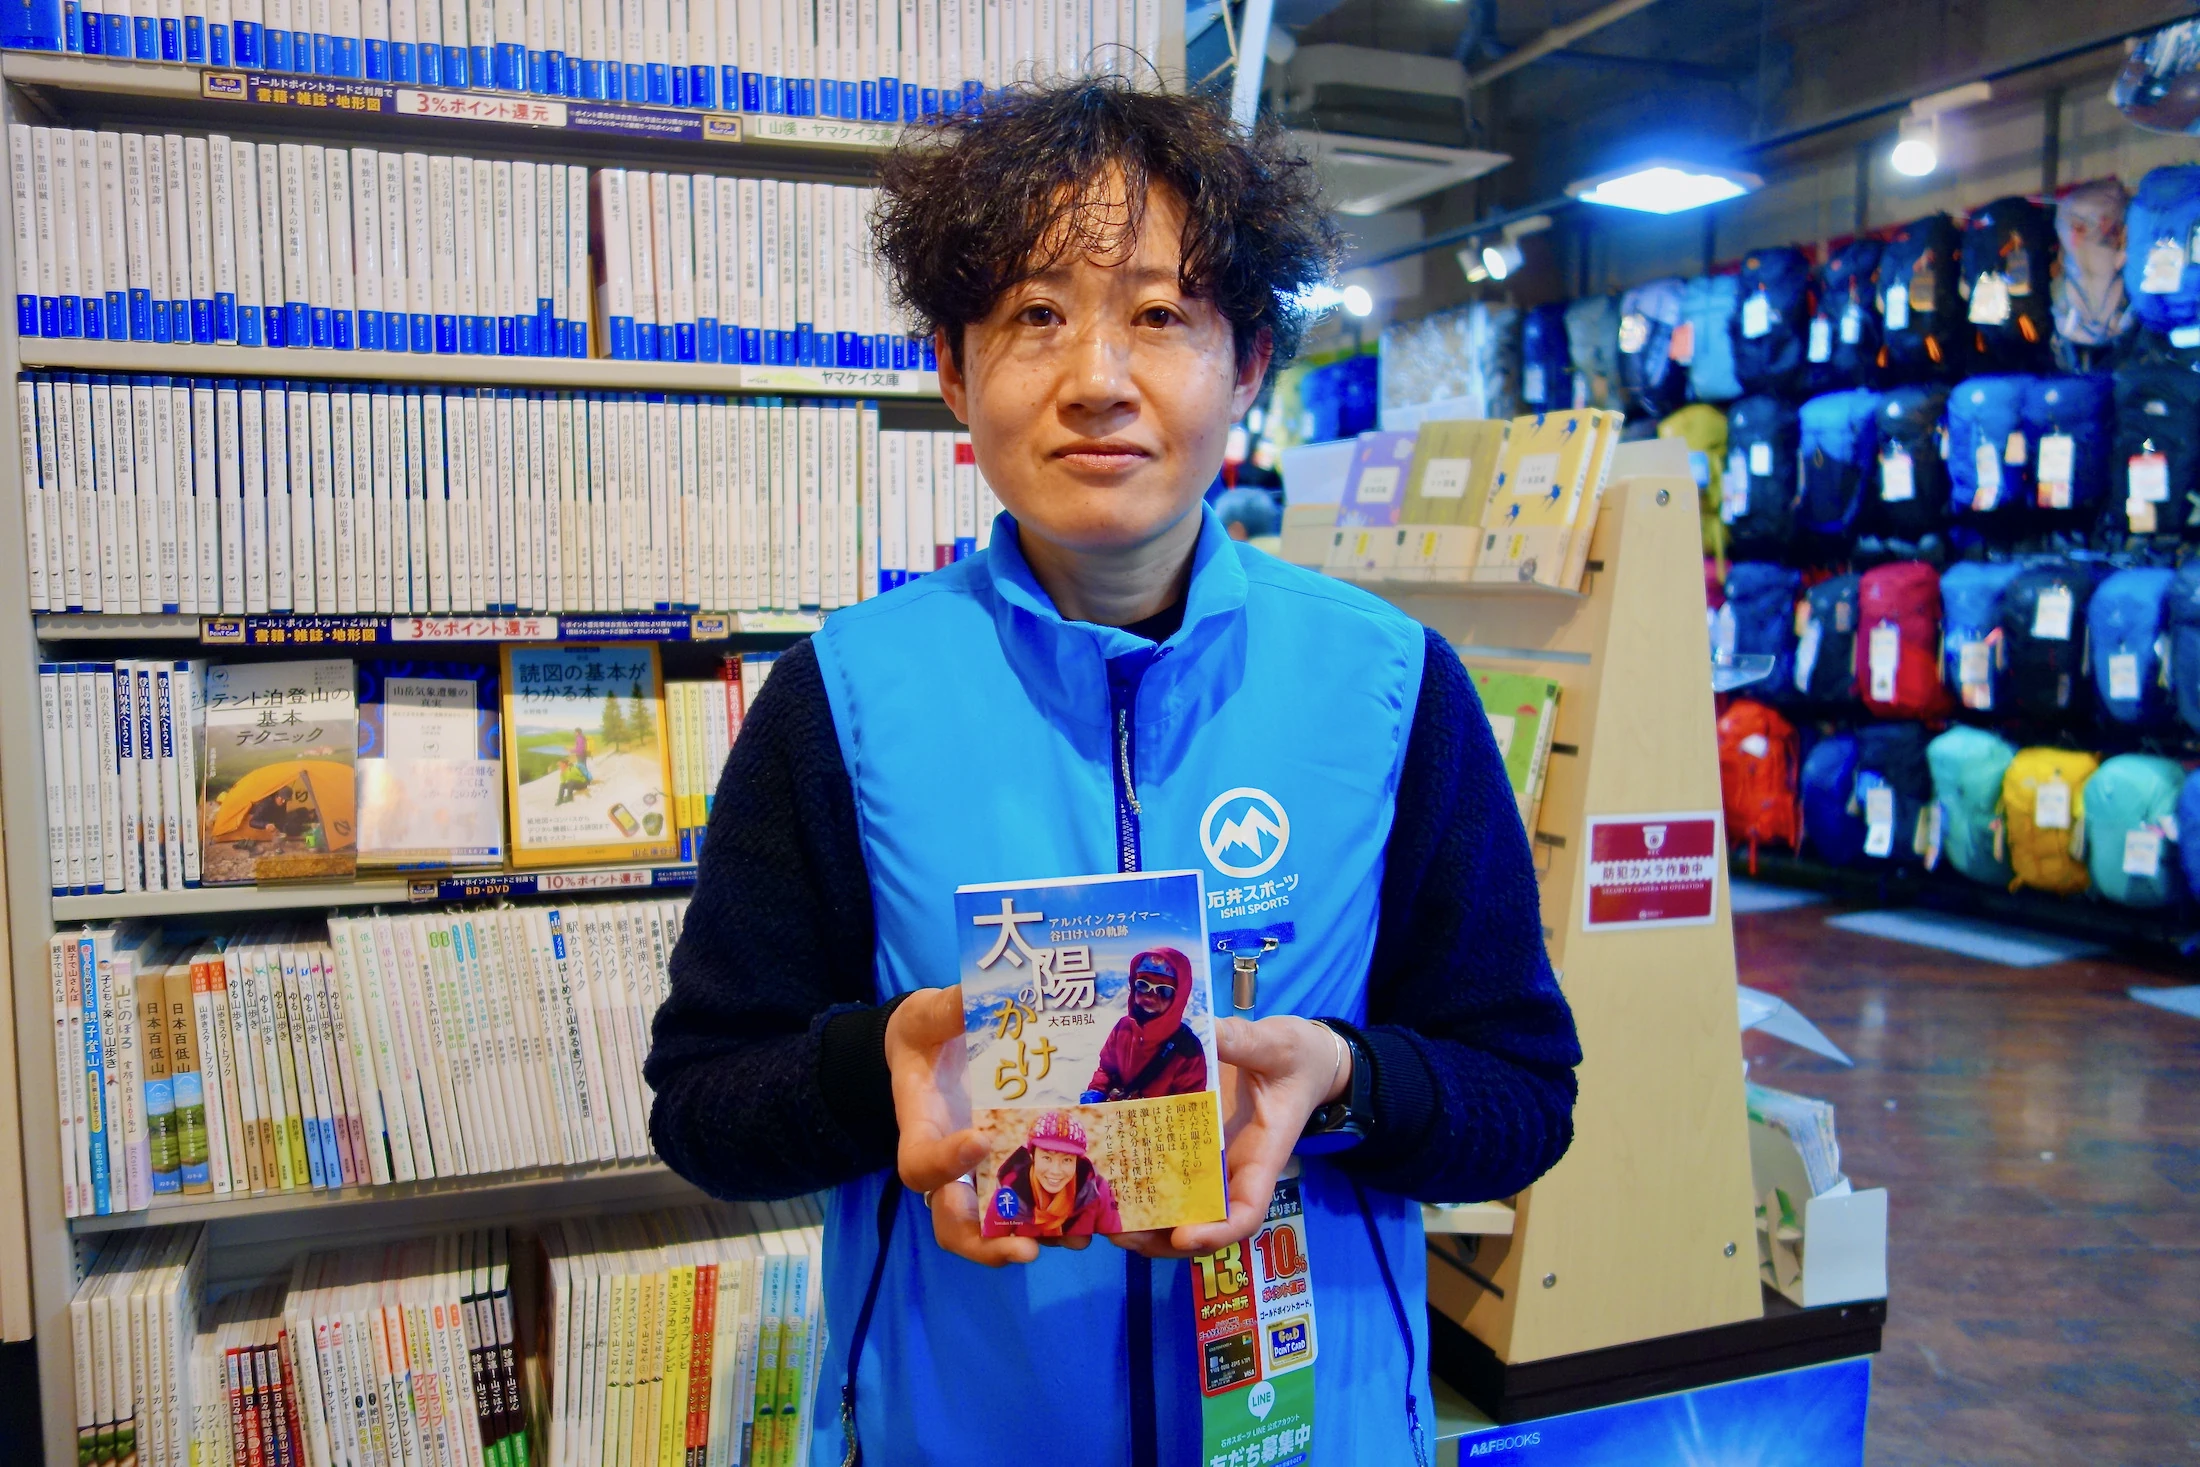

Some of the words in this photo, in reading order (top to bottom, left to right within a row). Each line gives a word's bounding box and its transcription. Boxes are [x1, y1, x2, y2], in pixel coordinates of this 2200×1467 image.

[250, 78, 393, 98] ゴールドポイントカードご利用で
[257, 88, 381, 112] 書籍・雑誌・地形図
[417, 92, 549, 122] 3%ポイント還元
[15, 154, 26, 199] 黒部の山賊
[37, 155, 48, 200] 黒部の山賊
[129, 156, 140, 207] 黒部の山人
[169, 142, 180, 190] マタギ奇談
[213, 143, 225, 205] 山怪実話大全
[333, 171, 342, 201] 単独行
[362, 158, 371, 198] 単独行者
[387, 163, 396, 203] 単独行者
[287, 166, 299, 256] 山小屋主人の炉端話
[822, 371, 899, 386] ヤマケイ文庫
[59, 396, 71, 468] もう道に迷わない
[76, 398, 89, 490] 山のリスクセンスを磨く本
[116, 399, 128, 473] 体験的登山技術論
[139, 400, 149, 464] 体験的山道具考
[357, 406, 367, 490] これでいいのか登山道
[392, 409, 402, 488] 日本の山はすごい！
[410, 408, 421, 496] 今そこにある山の危険
[516, 412, 526, 478] もう道に迷わない
[531, 412, 541, 481] アルピニズムと死
[249, 619, 387, 628] ゴールドポイントカードご利用で
[256, 629, 376, 642] 書籍・雑誌・地形図
[411, 620, 540, 638] 3%ポイント還元
[211, 687, 350, 708] テント泊登山の
[393, 686, 468, 697] 山岳気象遭難の
[519, 661, 646, 683] 読図の基本が
[521, 683, 599, 703] わかる本
[118, 675, 131, 758] 登山外来へようこそ
[138, 676, 151, 759] 登山外来へようこそ
[159, 677, 171, 758] 登山外来へようこそ
[257, 709, 304, 727] 基本
[421, 698, 442, 708] 真実
[179, 684, 189, 778] テント泊登山の基本テクニック
[236, 727, 324, 746] テクニック
[440, 876, 534, 887] ゴールドポイントカードご利用で
[466, 885, 510, 896] BD・DVD
[545, 873, 645, 891] 10%ポイント還元
[1206, 873, 1299, 909] 石井スポーツ
[1602, 863, 1704, 881] 防犯カメラ作動中
[1602, 887, 1632, 895] SECURITY
[1669, 883, 1704, 892] OPERATION
[1049, 911, 1160, 928] アルパインクライマー
[1221, 906, 1246, 919] ISHII
[1248, 895, 1290, 914] SPORTS
[566, 922, 586, 991] 駅からハイク
[584, 923, 602, 981] 秩父ハイク
[600, 922, 618, 980] 秩父ハイク
[617, 920, 636, 992] 軽井沢ハイク
[1050, 926, 1128, 942] 谷口けいの軌跡
[53, 946, 64, 1003] 親子で山さんぽ
[67, 945, 79, 1002] 親子で山さんぽ
[335, 933, 354, 1001] 低山トラベル
[360, 932, 378, 999] 低山トラベル
[381, 949, 399, 1008] 低山トラベル
[402, 948, 421, 1008] 低山トラベル
[503, 927, 518, 1000] アルプスはじめました
[635, 938, 652, 995] 湘南ハイク
[101, 974, 117, 1068] 子どもと楽しむ山歩き
[229, 980, 243, 1031] ゆる山歩き
[245, 979, 258, 1030] ゆる山歩き
[260, 995, 273, 1045] ゆる山歩き
[274, 991, 288, 1041] ゆる山歩き
[289, 992, 302, 1043] ゆる山歩き
[304, 994, 317, 1044] ゆる山歩き
[317, 991, 331, 1041] ゆる山歩き
[331, 992, 345, 1042] ゆる山歩き
[423, 965, 442, 1047] 東京近郊の入門山ハイク
[558, 963, 586, 1091] はじめての山あるきブック
[1048, 1014, 1095, 1027] 大石明弘
[83, 1012, 100, 1067] 親子登山
[147, 1003, 165, 1075] 日本百低山
[172, 1003, 190, 1074] 日本百低山
[199, 1006, 214, 1078] 山歩きスタートブック
[216, 1004, 231, 1076] 山歩きスタートブック
[1152, 1107, 1166, 1173] はじめて知った。
[1165, 1105, 1176, 1151] それを僕は
[1176, 1104, 1192, 1190] 向こうにあったもの。
[1188, 1102, 1202, 1168] 澄んだ眼差しの
[1201, 1100, 1212, 1145] けいさんの
[1116, 1110, 1131, 1205] 生きなくてはいけない。
[1128, 1109, 1143, 1204] 彼女の分まで僕たちは
[1254, 1224, 1308, 1283] 10%
[1201, 1296, 1249, 1320] ポイント還元
[1261, 1279, 1306, 1303] ポイント還元
[666, 1292, 680, 1373] シェラカップレシピ
[679, 1290, 692, 1370] シェラカップレシピ
[1273, 1343, 1291, 1358] POINT
[1291, 1339, 1306, 1352] CARD
[1278, 1327, 1300, 1344] GOLD
[337, 1366, 350, 1410] ホットサンド
[437, 1331, 454, 1404] アイラップのトリセツ
[454, 1328, 471, 1400] アイラップのトリセツ
[689, 1333, 701, 1414] シェラカップレシピ
[701, 1332, 711, 1412] シェラカップレシピ
[323, 1369, 336, 1413] ホットサンド
[1252, 1391, 1271, 1408] LINE
[382, 1382, 399, 1460] アイラップレシピ
[395, 1380, 412, 1457] アイラップレシピ
[1221, 1431, 1251, 1448] 石井スポーツ
[1252, 1425, 1266, 1438] LINE
[1267, 1414, 1300, 1432] 公式アカウント
[1469, 1431, 1541, 1457] A&FBOOKS
[1210, 1423, 1311, 1467] 友だち募集中
